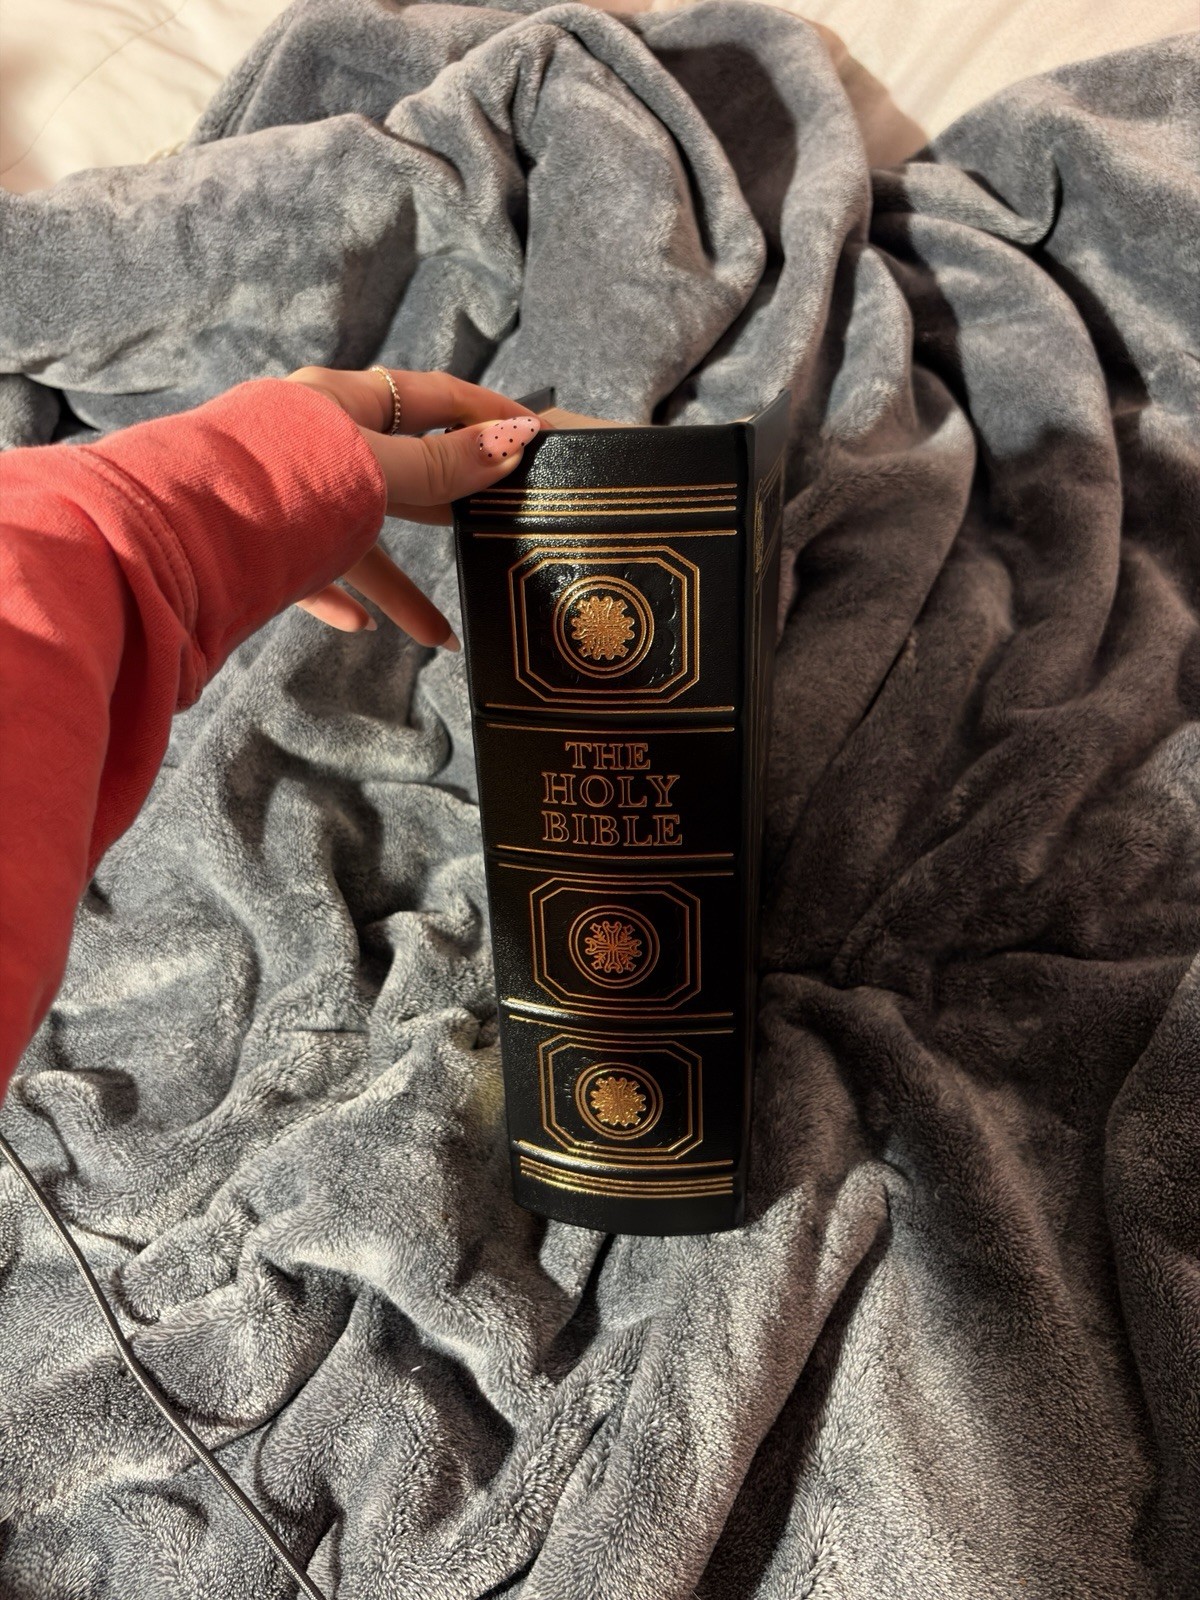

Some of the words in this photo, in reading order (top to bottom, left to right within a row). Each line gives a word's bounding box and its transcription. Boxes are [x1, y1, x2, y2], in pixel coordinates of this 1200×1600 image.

[565, 741, 651, 770] THE
[541, 771, 681, 808] HOLY
[541, 810, 683, 847] BIBLE
